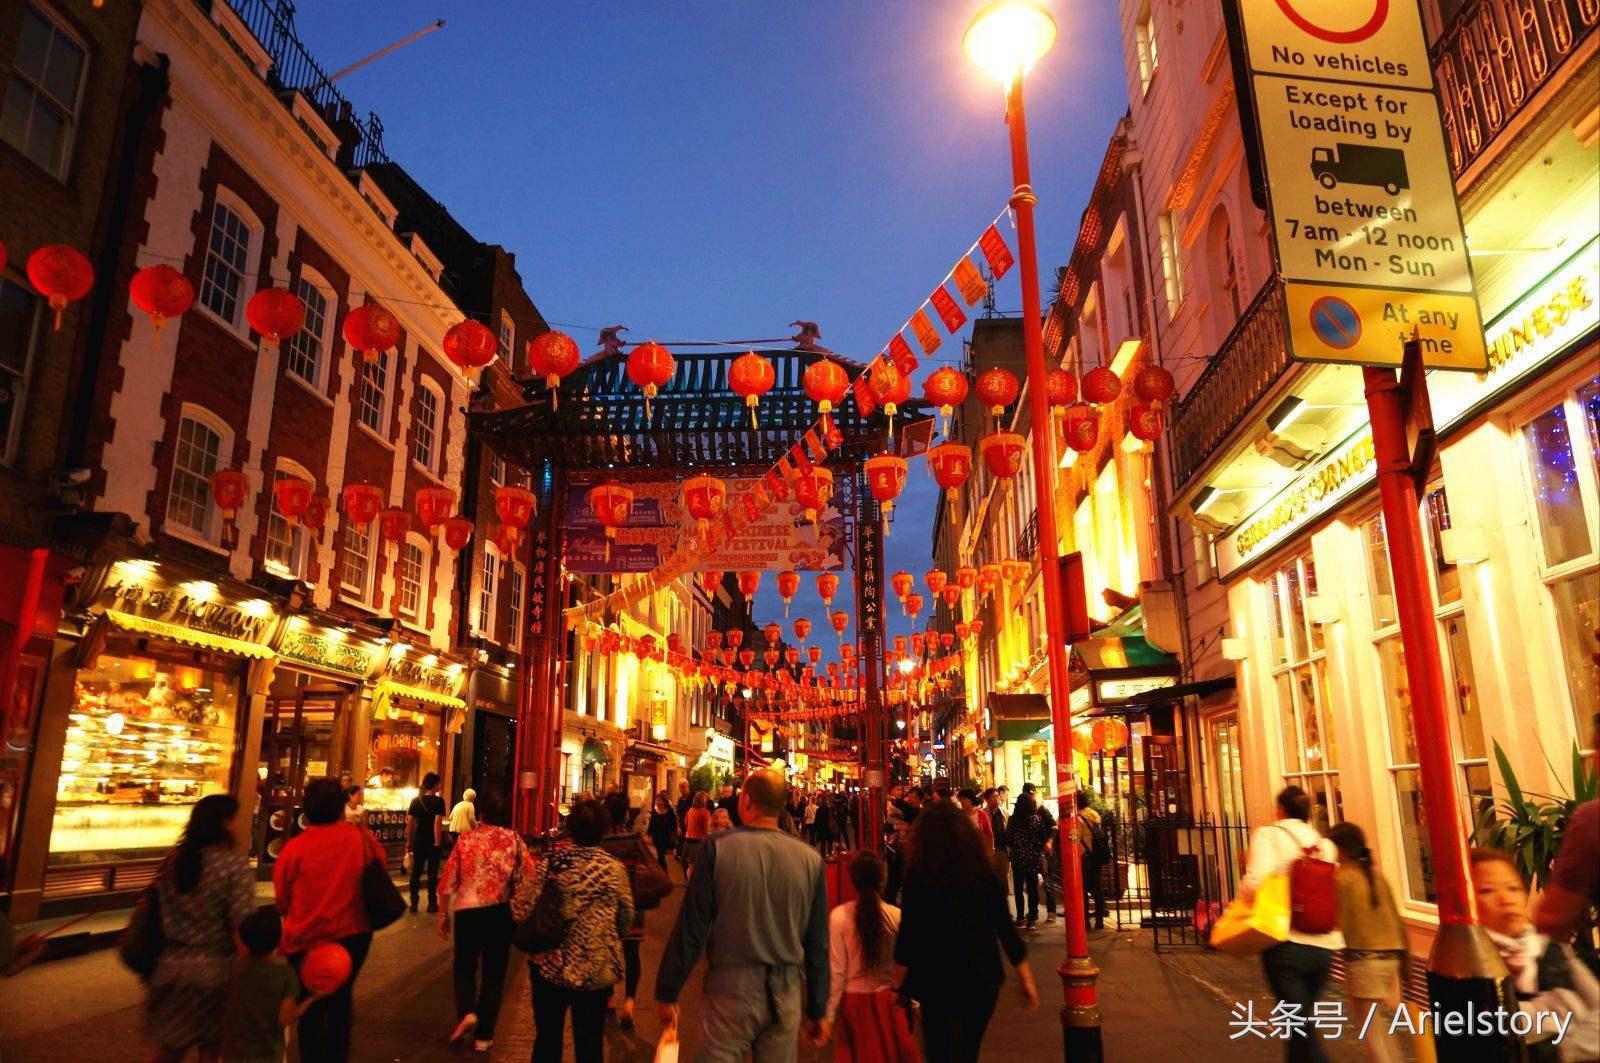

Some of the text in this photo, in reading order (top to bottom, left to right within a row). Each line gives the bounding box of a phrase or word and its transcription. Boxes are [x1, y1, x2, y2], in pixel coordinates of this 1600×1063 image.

[1271, 45, 1409, 76] No vehicles
[1285, 85, 1408, 115] Except for
[1289, 110, 1412, 143] loading by
[1315, 195, 1418, 223] between
[1362, 226, 1388, 246] 12
[1397, 233, 1455, 252] noon
[1315, 249, 1368, 272] Mon
[1388, 254, 1436, 277] Sun
[1382, 302, 1459, 330] At any
[1474, 276, 1592, 382] HINESE
[1398, 331, 1453, 354] tme
[725, 538, 790, 550] FESTIVAL
